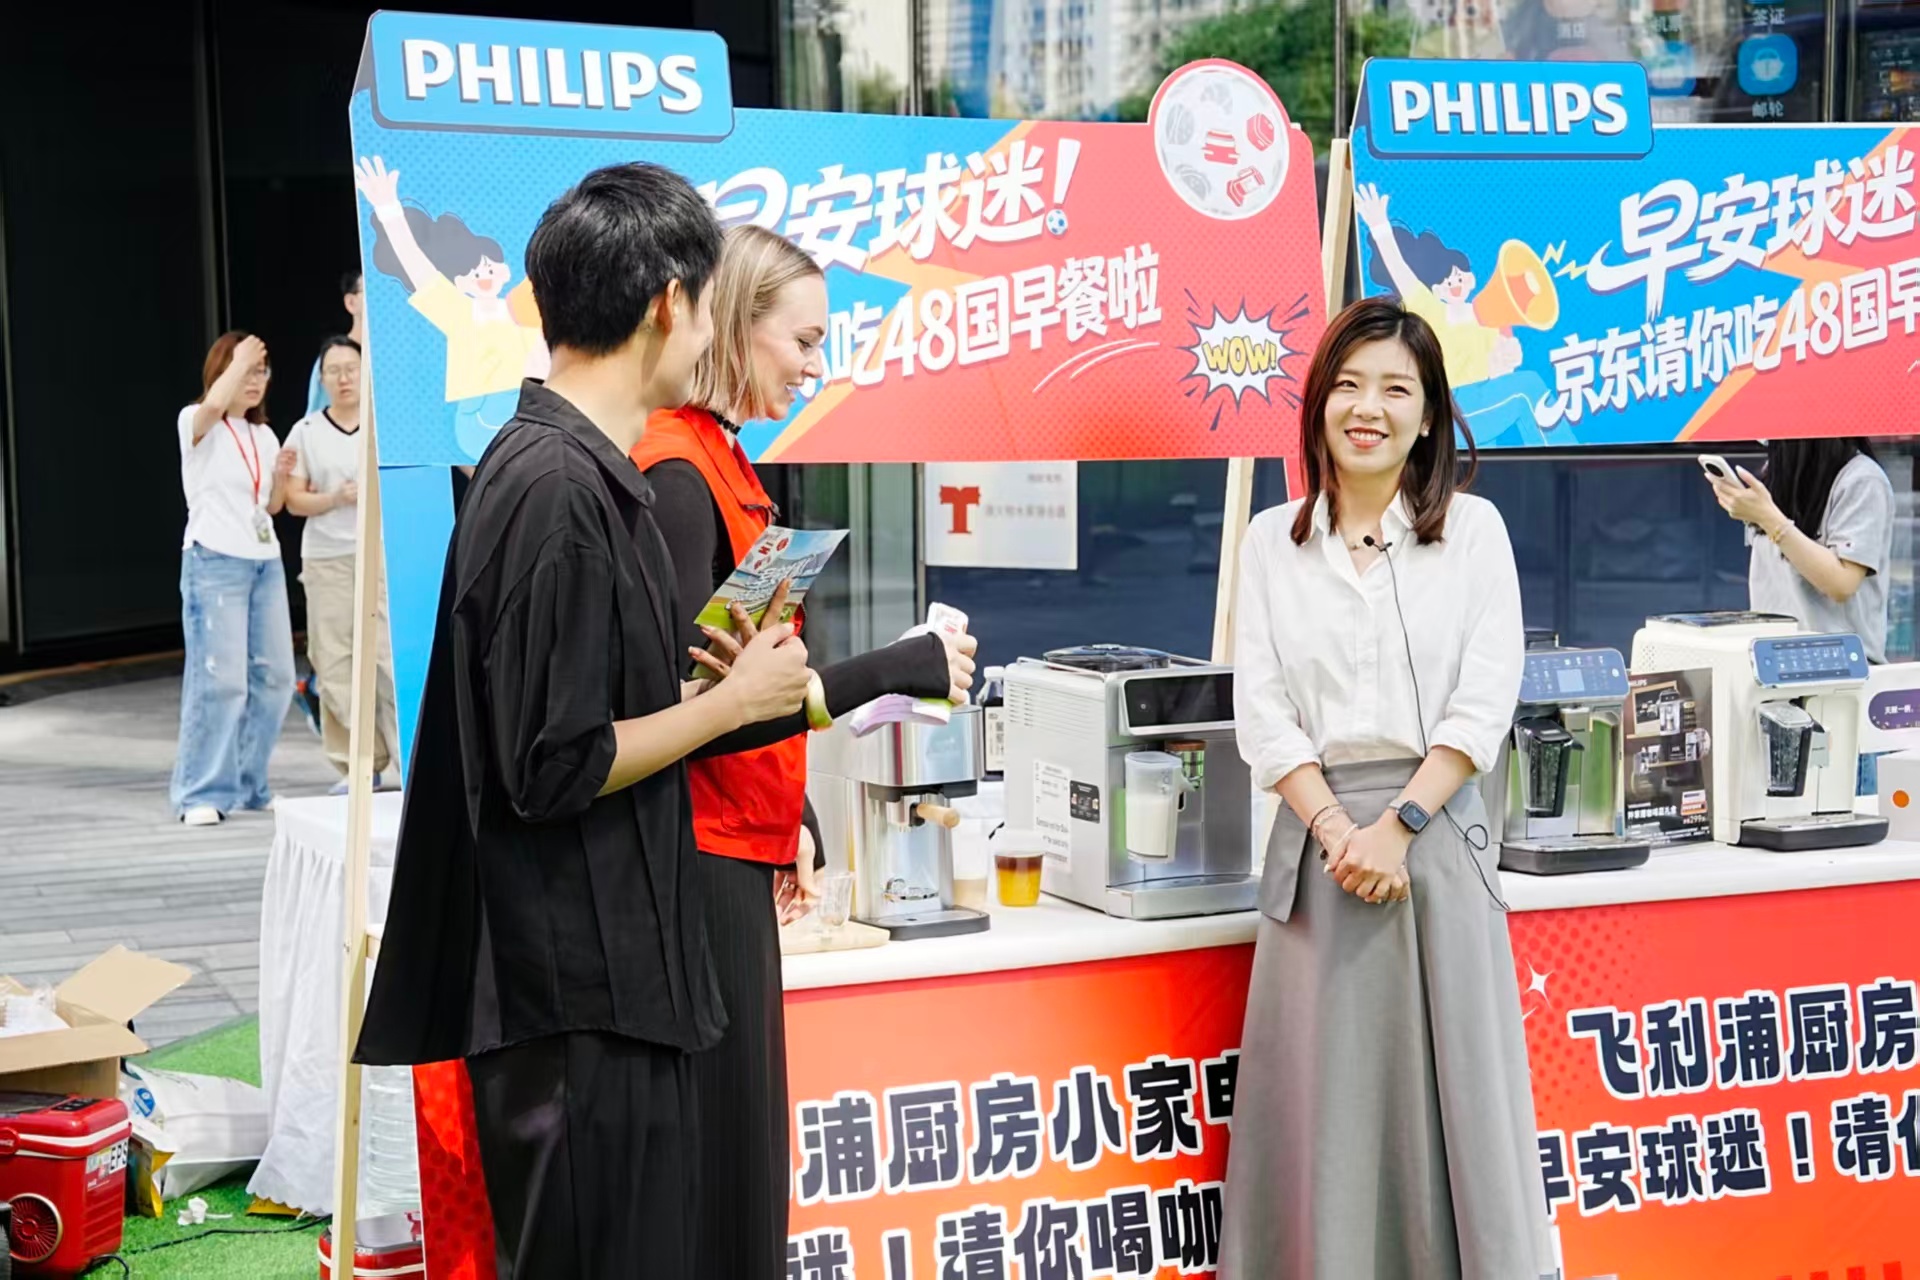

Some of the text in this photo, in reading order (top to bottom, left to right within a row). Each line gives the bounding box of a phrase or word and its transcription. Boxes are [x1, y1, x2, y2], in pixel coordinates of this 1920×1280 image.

[1752, 8, 1785, 26] 签证
[403, 39, 703, 113] PHILIPS
[1389, 80, 1629, 136] PHILIPS
[1752, 100, 1784, 118] 邮轮
[1586, 145, 1917, 320] 早安球迷
[800, 244, 1162, 397] 吃48国早餐啦
[1201, 335, 1277, 377] WOW!
[1535, 258, 1920, 428] 京东请你吃48国早
[1567, 977, 1918, 1100] 飞利浦厨房
